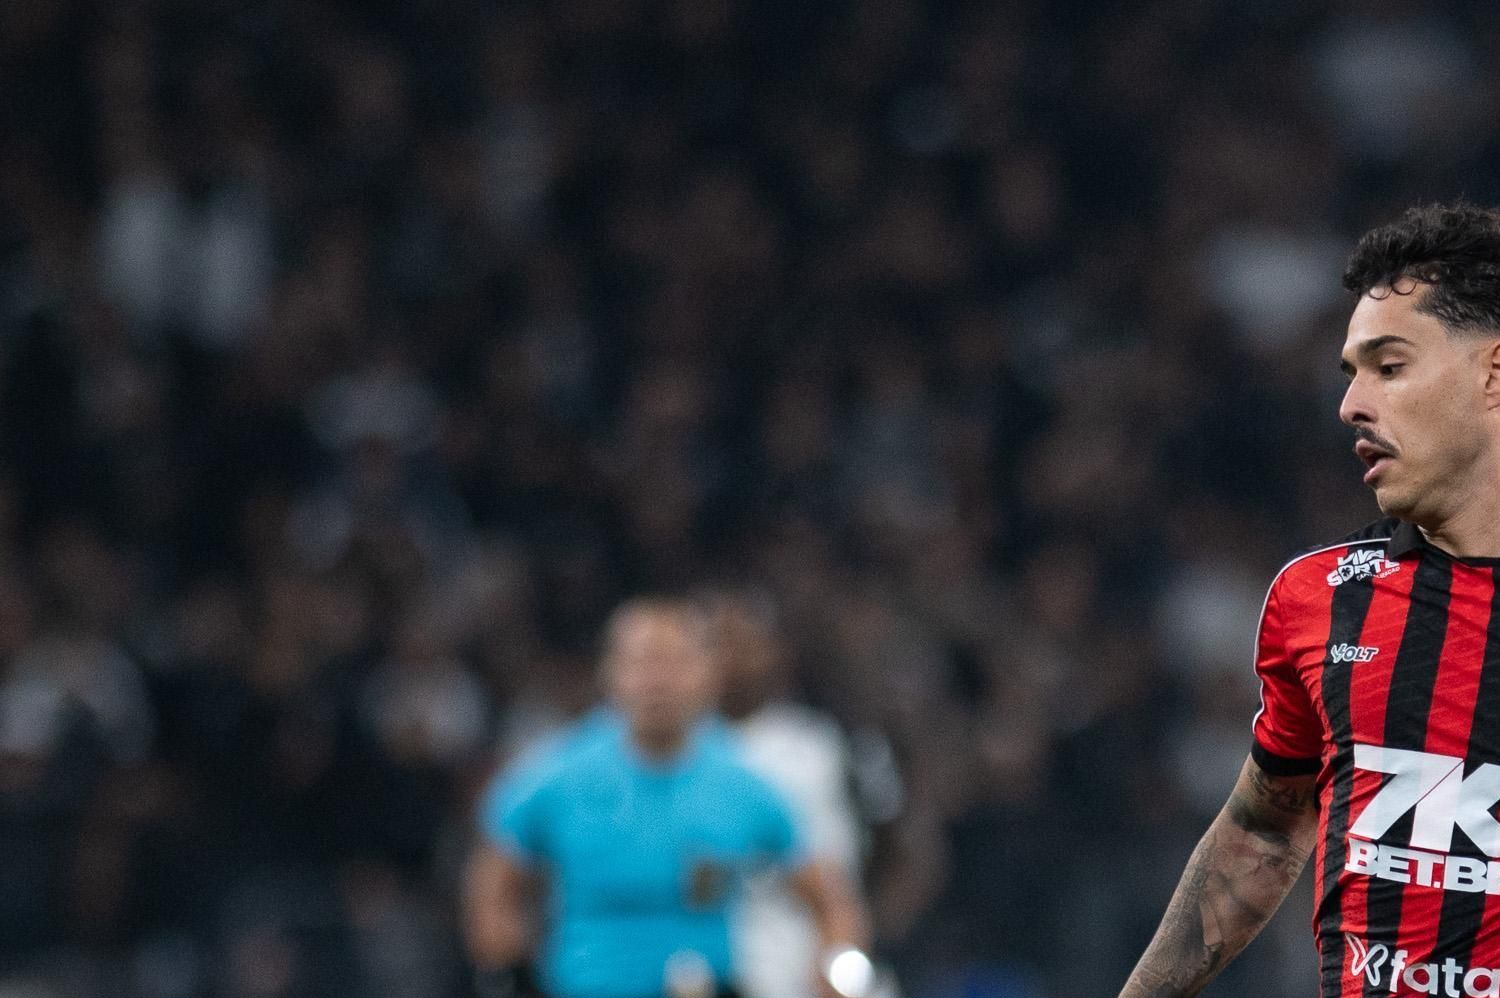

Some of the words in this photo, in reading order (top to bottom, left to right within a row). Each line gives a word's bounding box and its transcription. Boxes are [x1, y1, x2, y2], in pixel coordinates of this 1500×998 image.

[1337, 549, 1385, 566] VIVA
[1326, 558, 1401, 587] SORTE
[1330, 643, 1380, 664] VOLT
